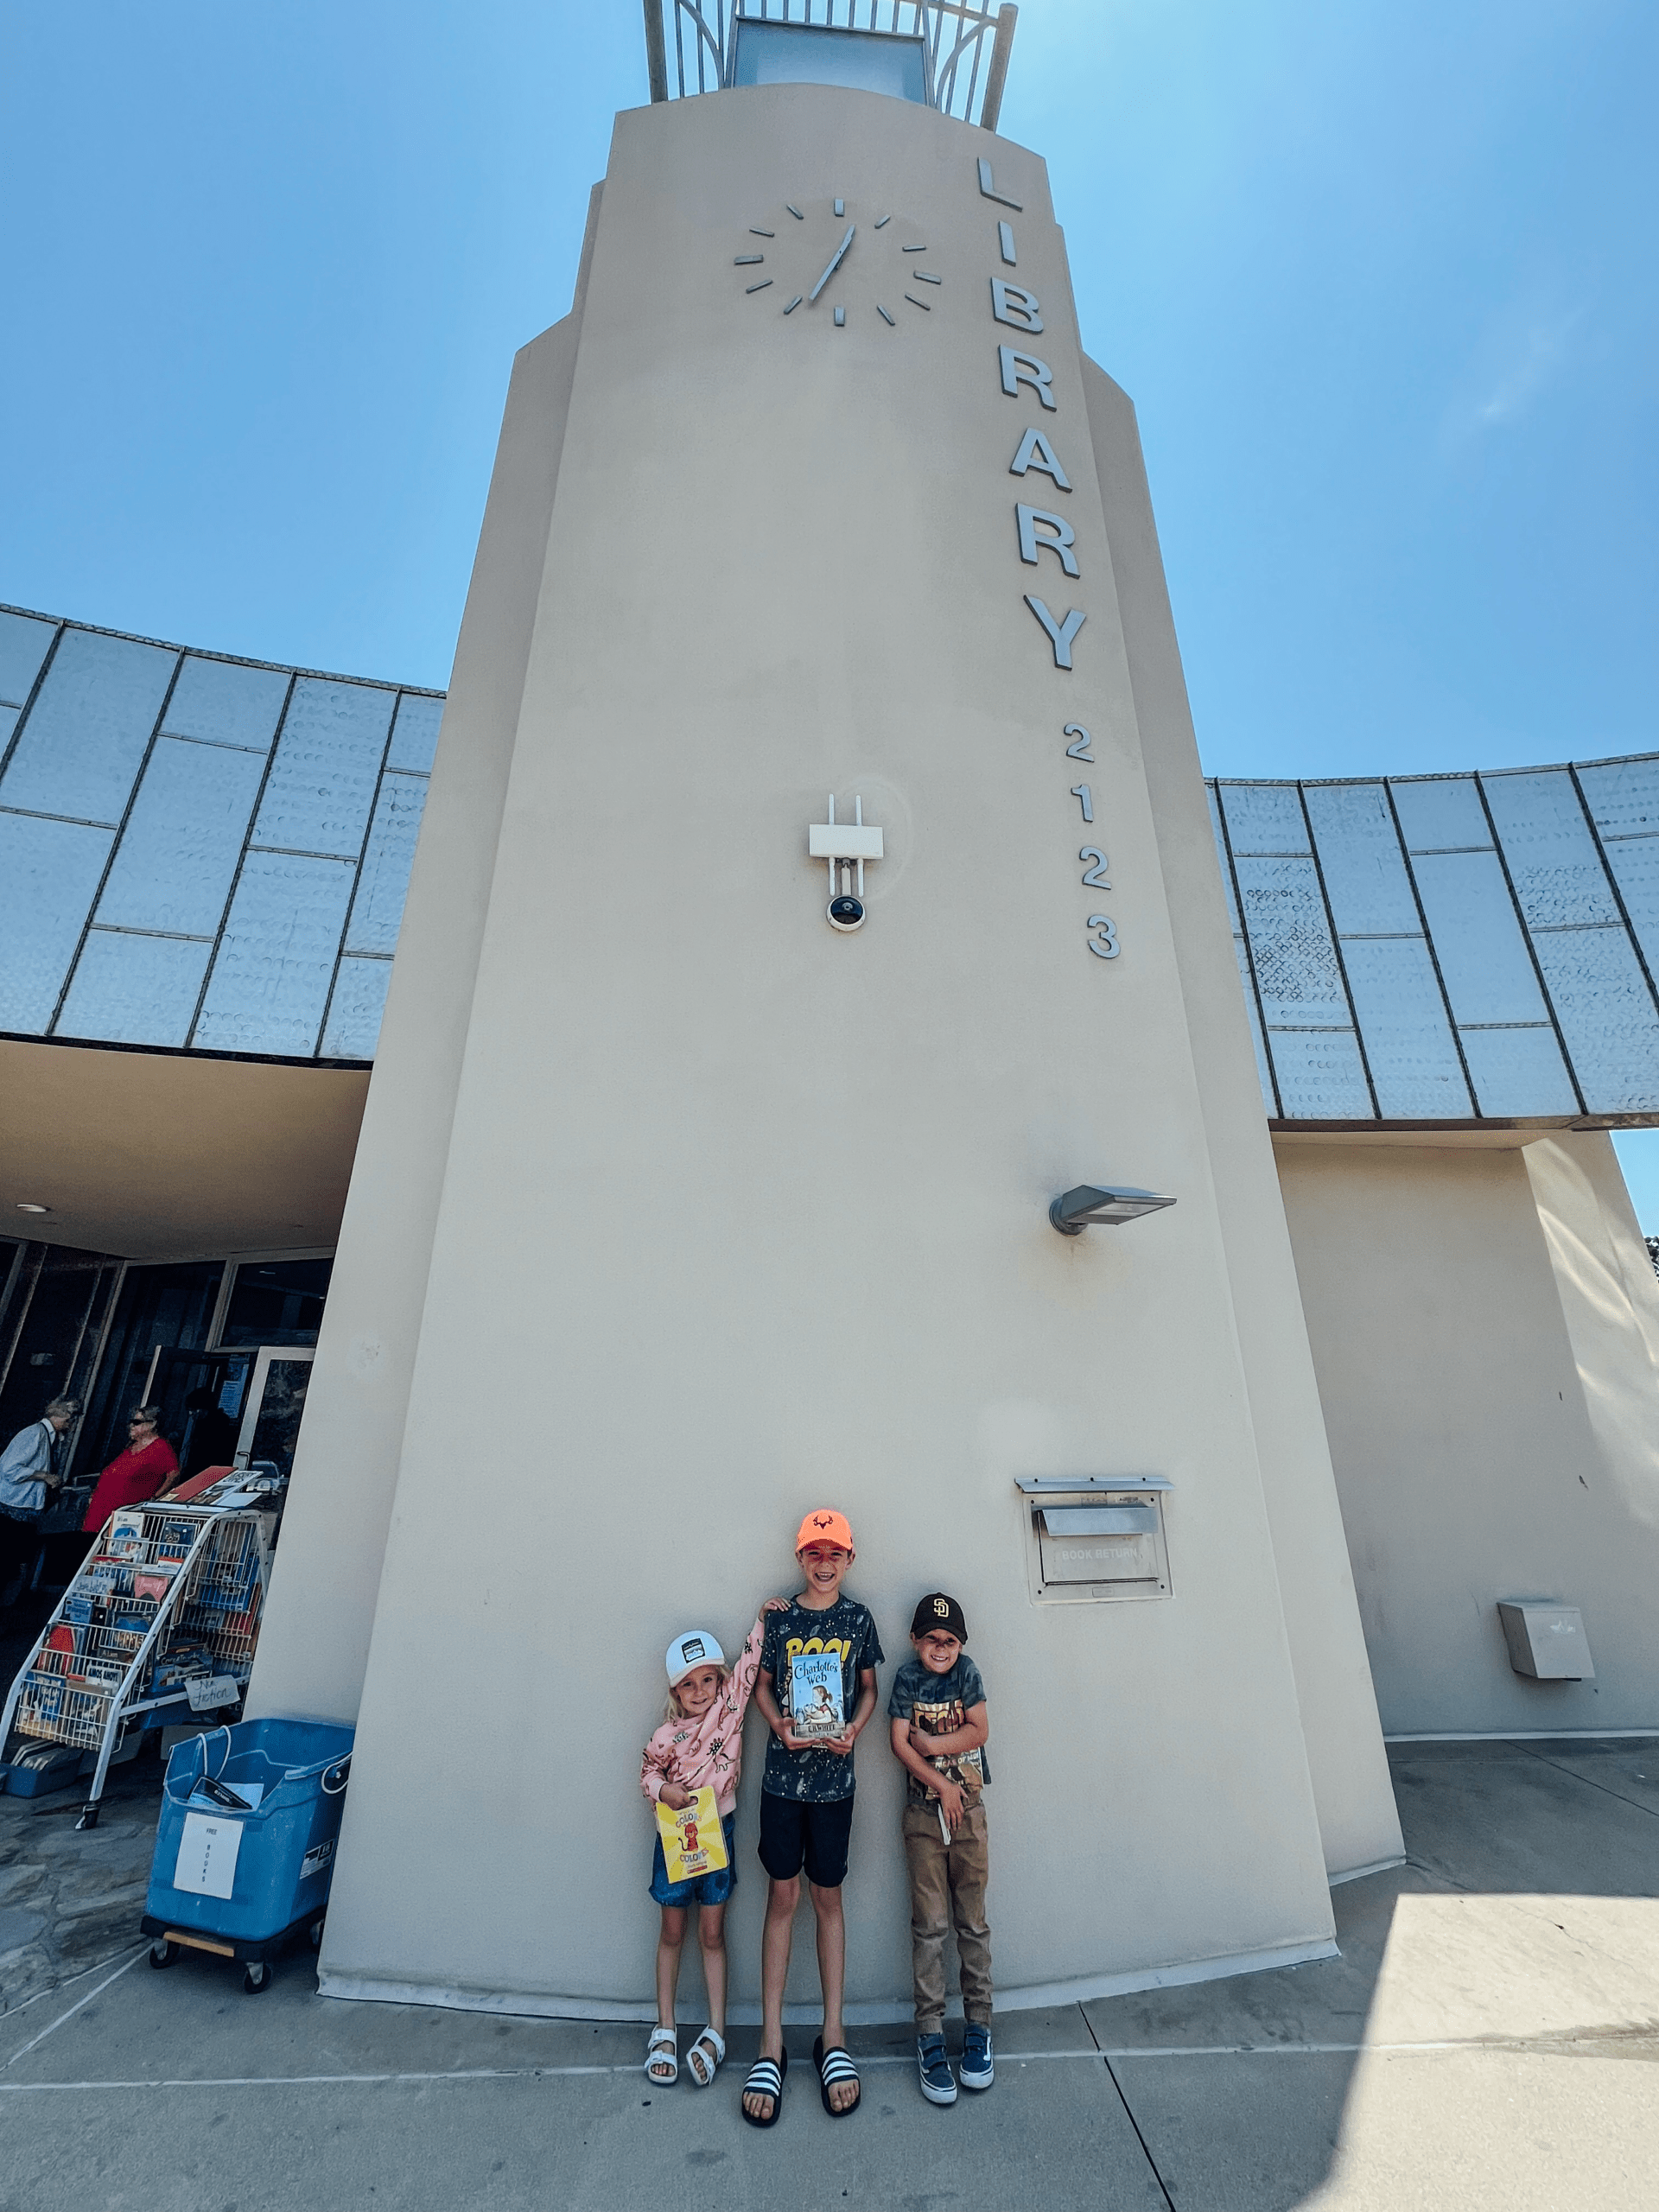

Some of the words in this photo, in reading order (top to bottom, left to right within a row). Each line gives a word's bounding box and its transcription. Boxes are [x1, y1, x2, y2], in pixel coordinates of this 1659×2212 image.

[977, 156, 1087, 671] LIBRARY
[1063, 722, 1122, 960] 2123
[1062, 1549, 1093, 1560] BOOK
[1095, 1548, 1138, 1560] RETURN
[933, 1598, 950, 1618] SD
[794, 1660, 838, 1680] Charlotte's
[806, 1671, 828, 1686] Web
[201, 1844, 211, 1883] BOOKS
